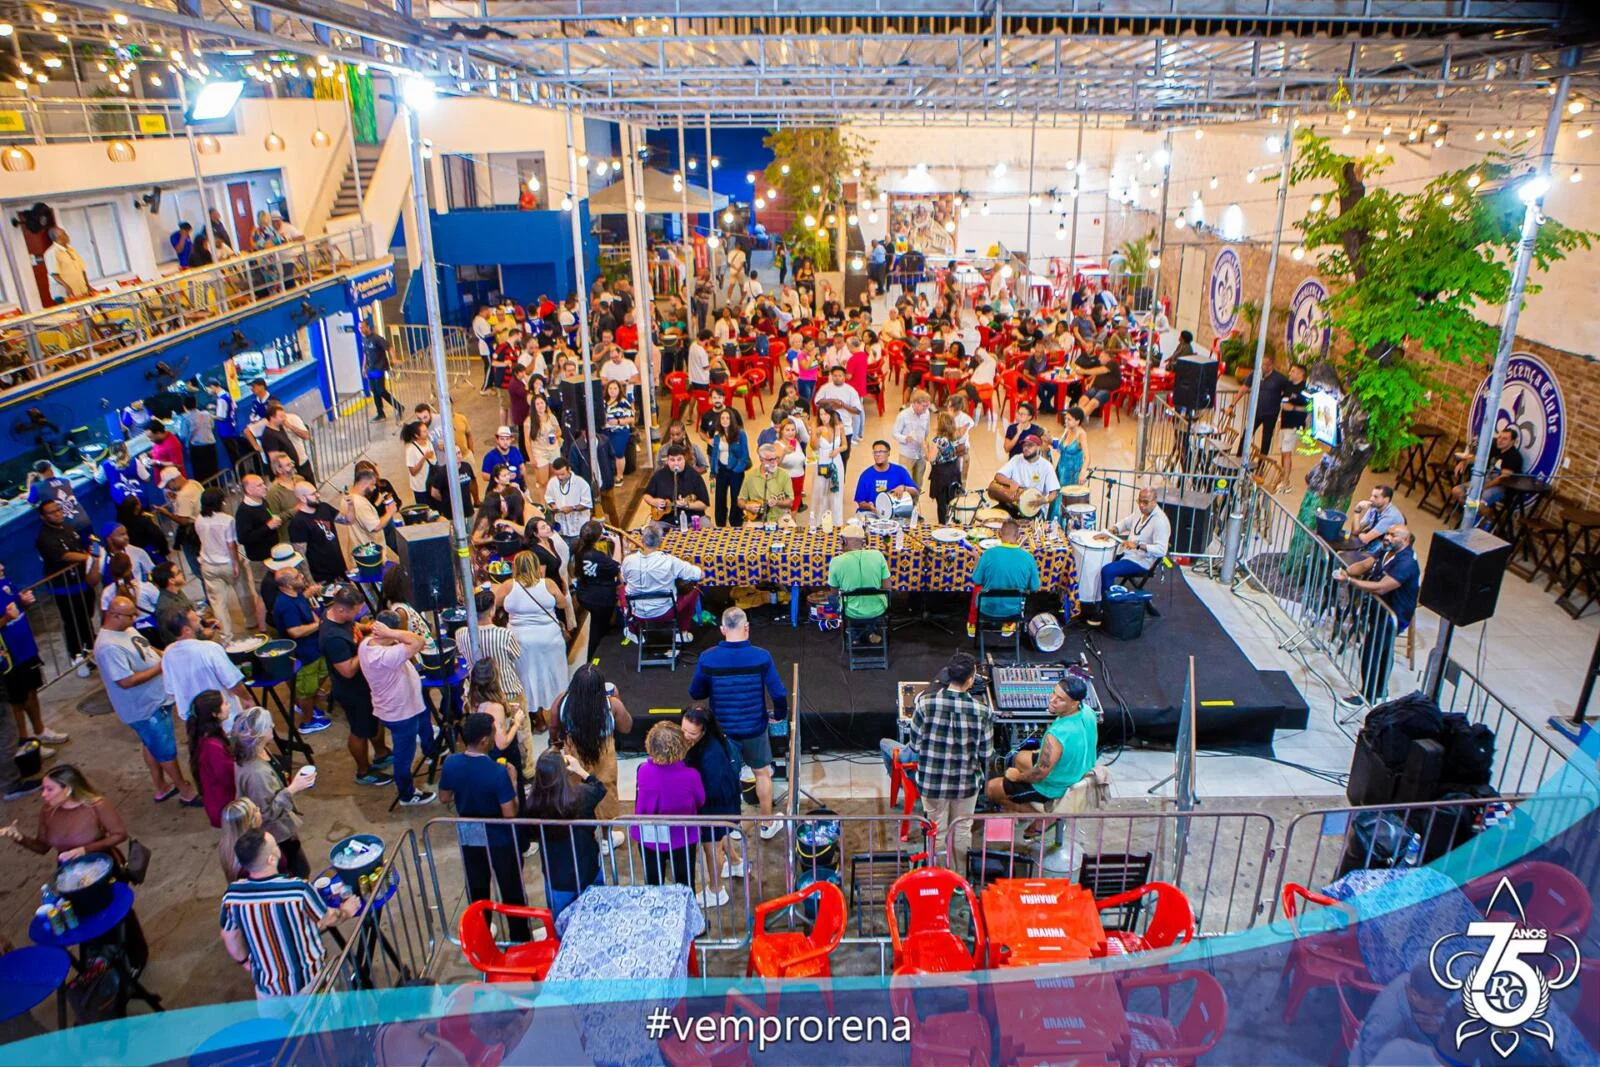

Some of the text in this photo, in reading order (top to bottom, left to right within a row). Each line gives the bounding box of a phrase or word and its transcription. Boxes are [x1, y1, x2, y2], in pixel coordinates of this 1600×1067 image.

[1541, 383, 1560, 434] Clube
[919, 888, 939, 896] BRAHMA
[1020, 895, 1058, 904] BRAHMA
[1026, 928, 1066, 938] BRAHMA
[1043, 1017, 1085, 1029] BRAHMA
